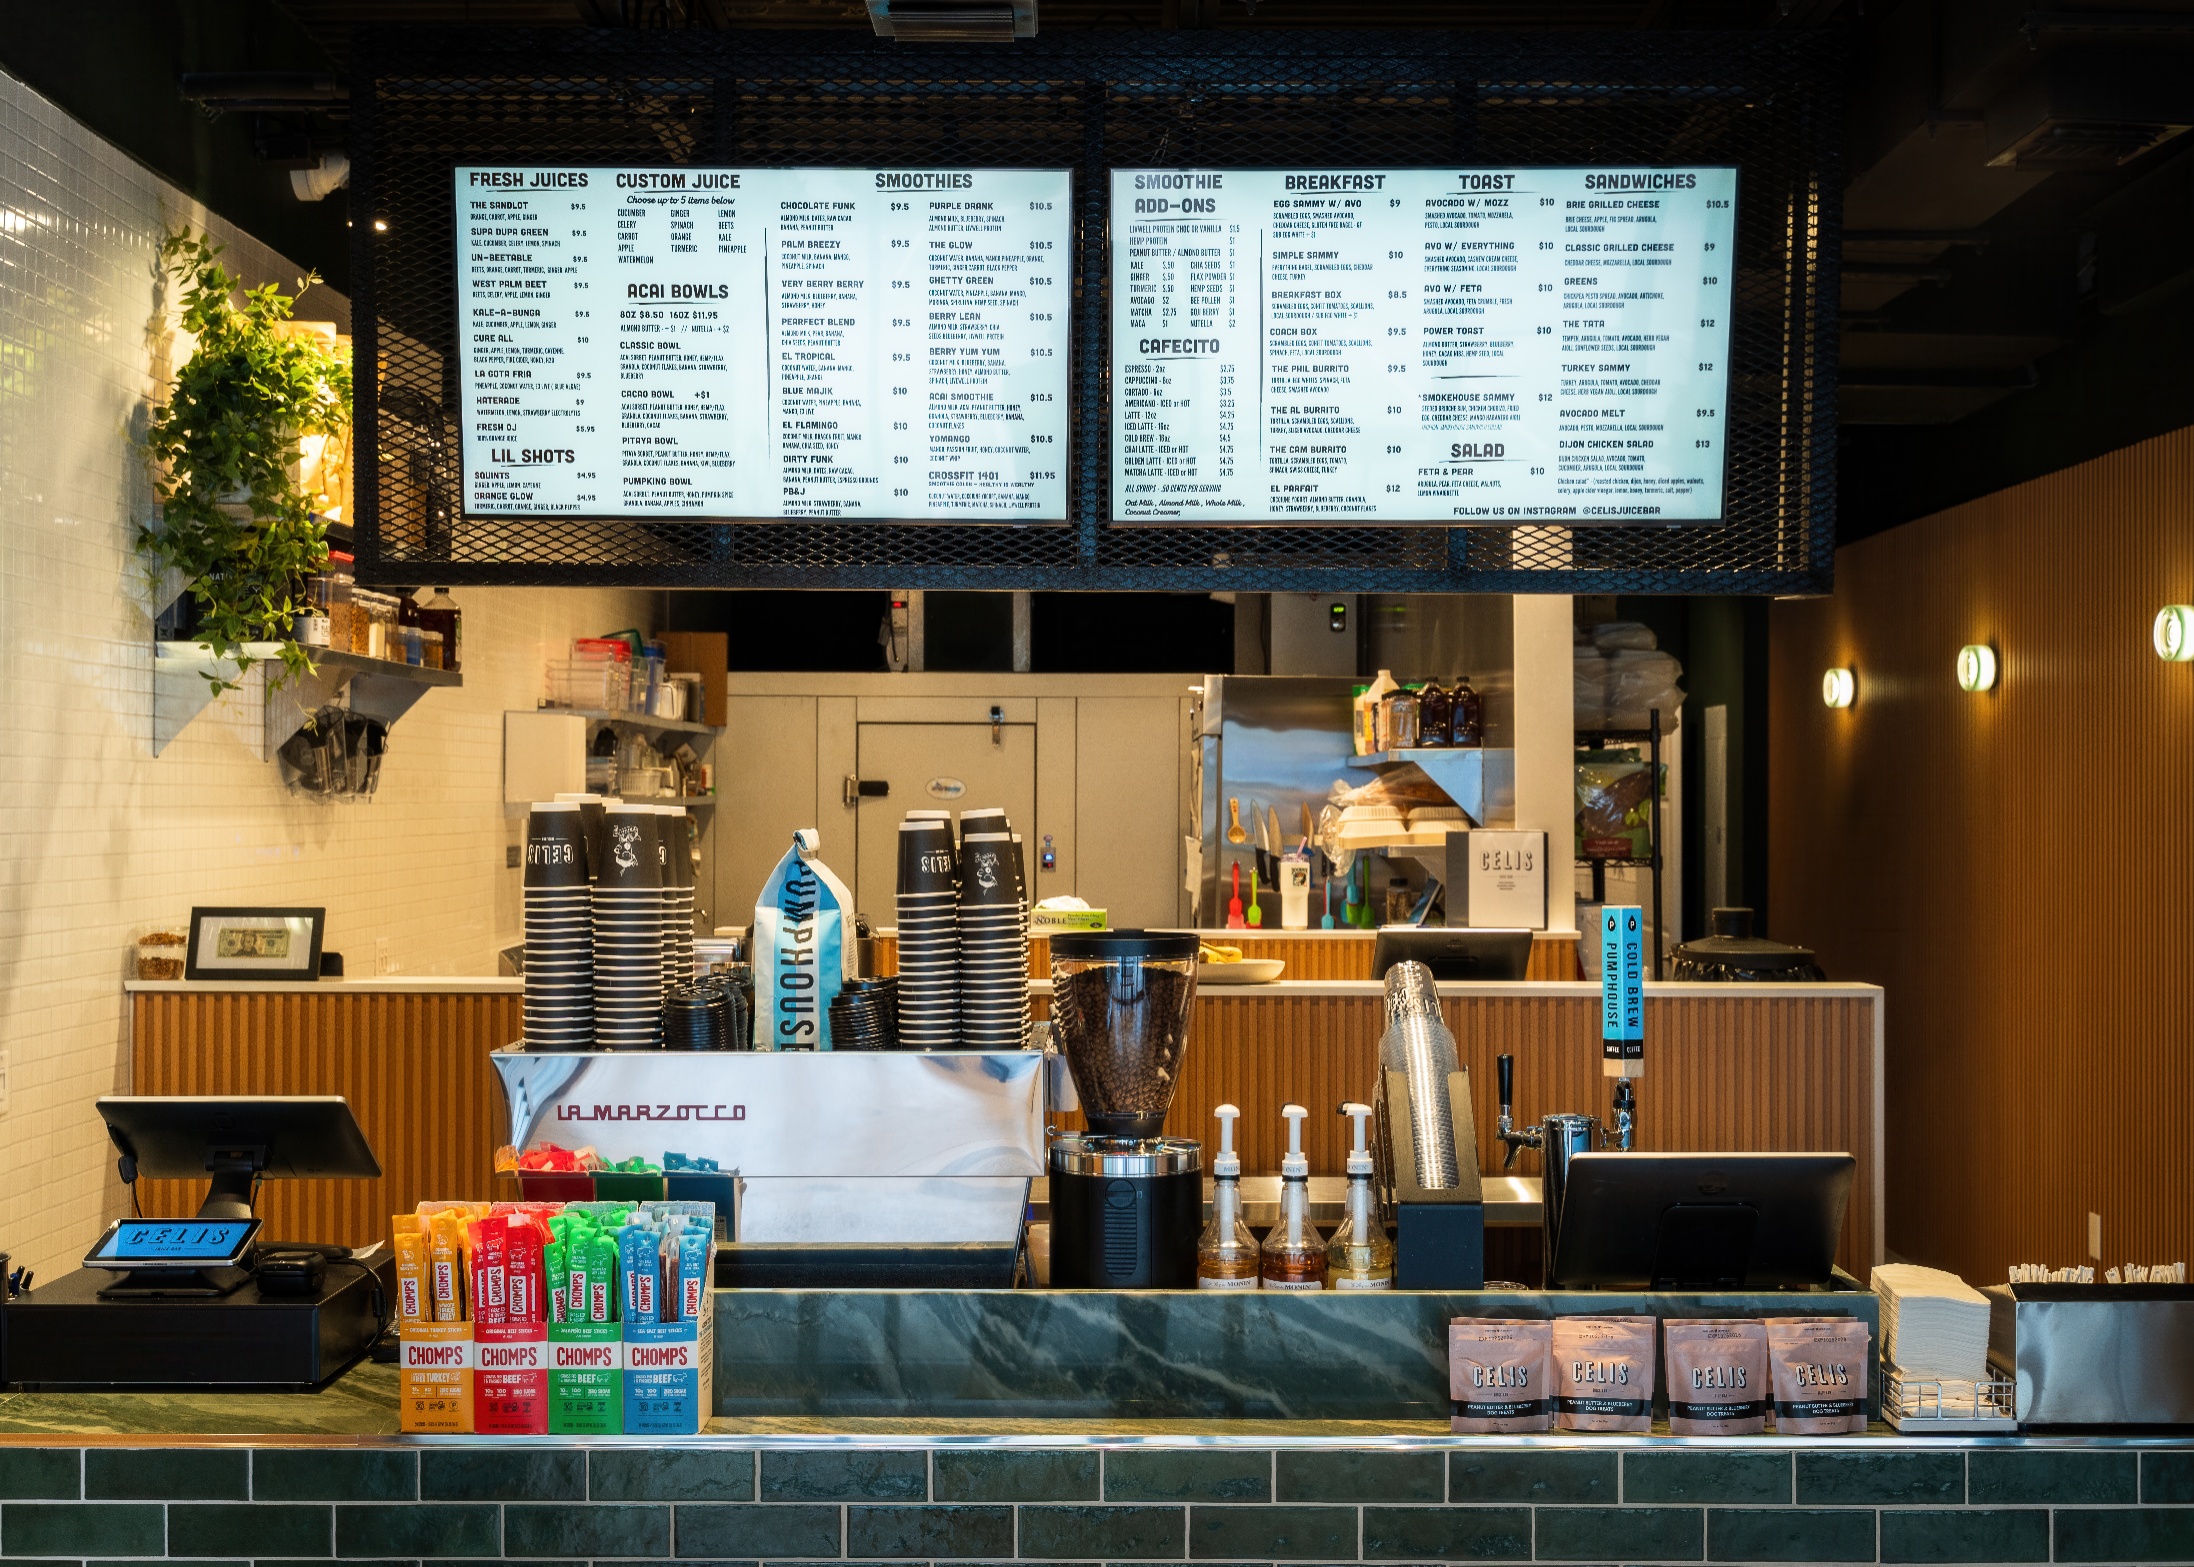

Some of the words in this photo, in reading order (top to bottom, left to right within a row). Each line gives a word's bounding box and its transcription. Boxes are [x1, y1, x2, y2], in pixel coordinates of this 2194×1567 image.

[470, 172, 523, 187] FRESH
[530, 173, 588, 187] JUICES
[617, 174, 687, 190] CUSTOM
[691, 174, 740, 188] JUICE
[876, 173, 972, 190] SMOOTHIES
[1135, 175, 1222, 189] SMOOTHIE
[1286, 175, 1386, 191] BREAKFAST
[1459, 175, 1515, 191] TOAST
[1585, 174, 1696, 191] SANDWICHES
[679, 196, 686, 204] 5
[712, 196, 735, 204] below
[1030, 202, 1052, 210] $10.5
[1135, 198, 1215, 213] ADD-ONS
[1389, 251, 1403, 259] $10
[1703, 277, 1717, 285] $10
[628, 284, 664, 298] ACAI
[672, 284, 728, 298] BOWLS
[1163, 308, 1176, 316] $2.75
[1140, 339, 1219, 353] CAFECITO
[1699, 363, 1712, 371] $12
[1697, 409, 1714, 417] $9.5
[1031, 435, 1052, 443] $10.5
[492, 449, 515, 462] LIL
[522, 449, 574, 463] SHOTS
[1451, 444, 1504, 457] SALAD
[929, 472, 974, 482] CROSSFIT
[978, 472, 998, 480] 1401
[1480, 850, 1533, 871] CELIS
[1627, 943, 1637, 979] COLD
[1607, 943, 1618, 1028] PUMPHOUSE
[1628, 987, 1638, 1028] BREW
[558, 1105, 580, 1120] LA
[594, 1105, 745, 1120] MARZOCCO
[126, 1228, 229, 1244] CELIS
[438, 1264, 450, 1299] CHOMPS
[491, 1269, 502, 1303] CHOMPS
[404, 1280, 416, 1315] CHOMPS
[512, 1278, 524, 1313] CHOMPS
[571, 1274, 583, 1308] CHOMPS
[640, 1276, 651, 1311] CHOMPS
[687, 1280, 698, 1315] CHOMPS
[593, 1285, 604, 1320] CHOMPS
[409, 1346, 463, 1365] CHOMPS
[482, 1347, 537, 1366] CHOMPS
[557, 1347, 612, 1366] CHOMPS
[632, 1347, 687, 1366] CHOMPS
[426, 1374, 450, 1382] TURKEY
[503, 1375, 521, 1384] BEEF
[578, 1374, 596, 1383] BEEF
[653, 1374, 672, 1383] BEEF
[1472, 1366, 1528, 1387] CELIS
[1572, 1361, 1628, 1384] CELIS
[1692, 1366, 1746, 1389] CELIS
[1795, 1364, 1848, 1386] CELIS
